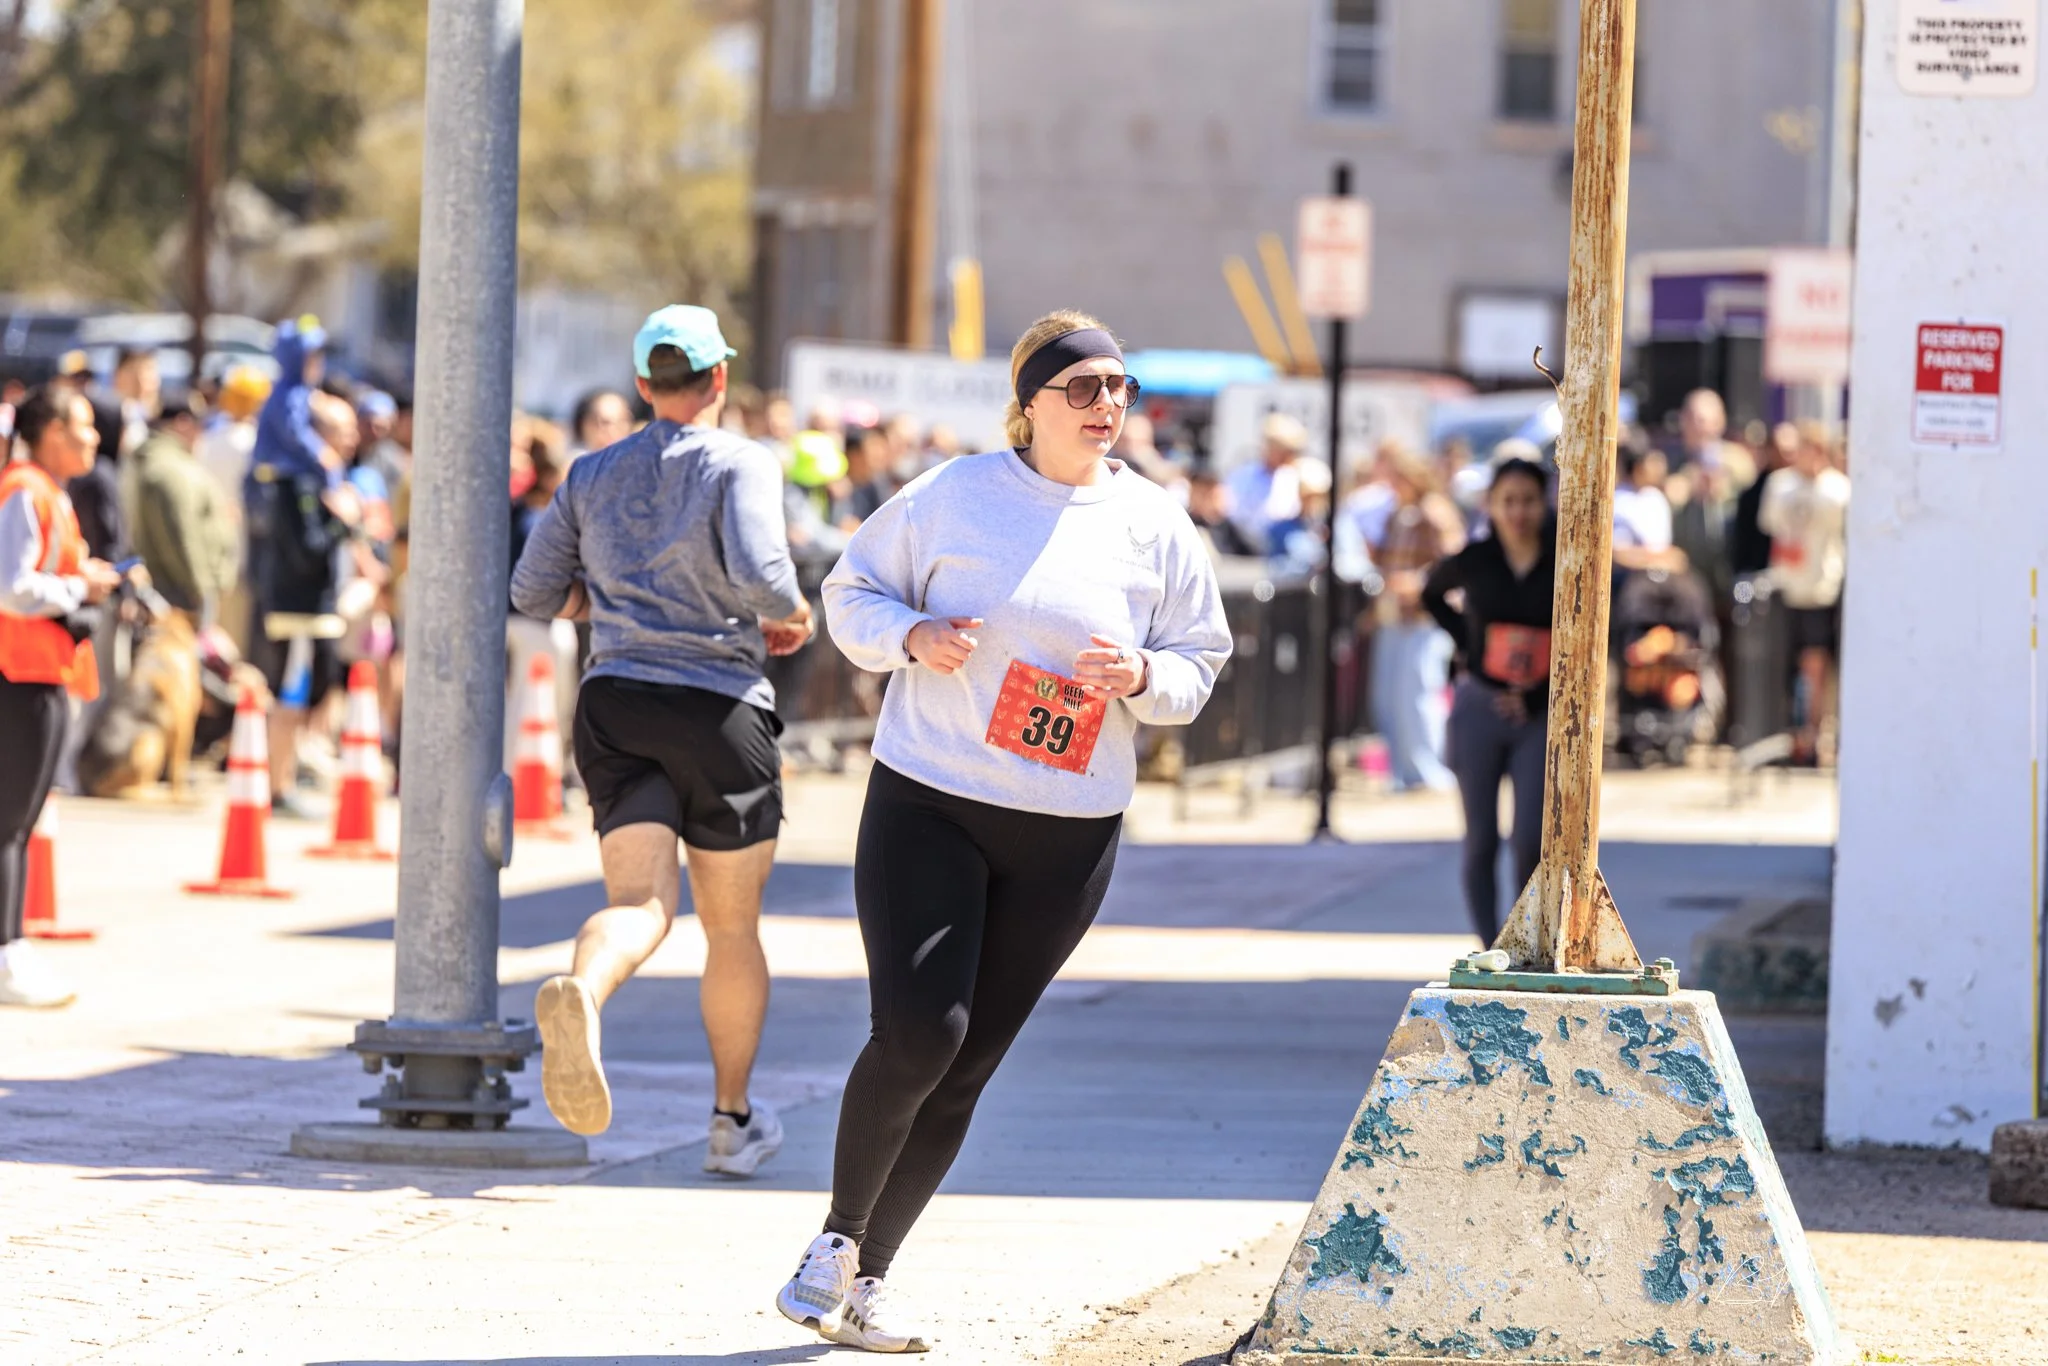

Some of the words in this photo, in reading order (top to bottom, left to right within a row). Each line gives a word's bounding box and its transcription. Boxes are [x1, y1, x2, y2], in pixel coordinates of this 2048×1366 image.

[1916, 18, 1947, 29] THIS
[1950, 19, 2022, 30] PROPERTY
[1925, 33, 2006, 45] PROTECTED
[1949, 49, 1990, 58] VIDEO
[1916, 62, 2020, 75] SURVEILLANCE
[1921, 327, 2000, 351] RESERVED
[1923, 349, 1995, 372] PARKING
[1941, 371, 1974, 392] FOR
[1064, 684, 1085, 700] BEER
[1063, 696, 1082, 711] MILE
[1021, 705, 1075, 755] 39
